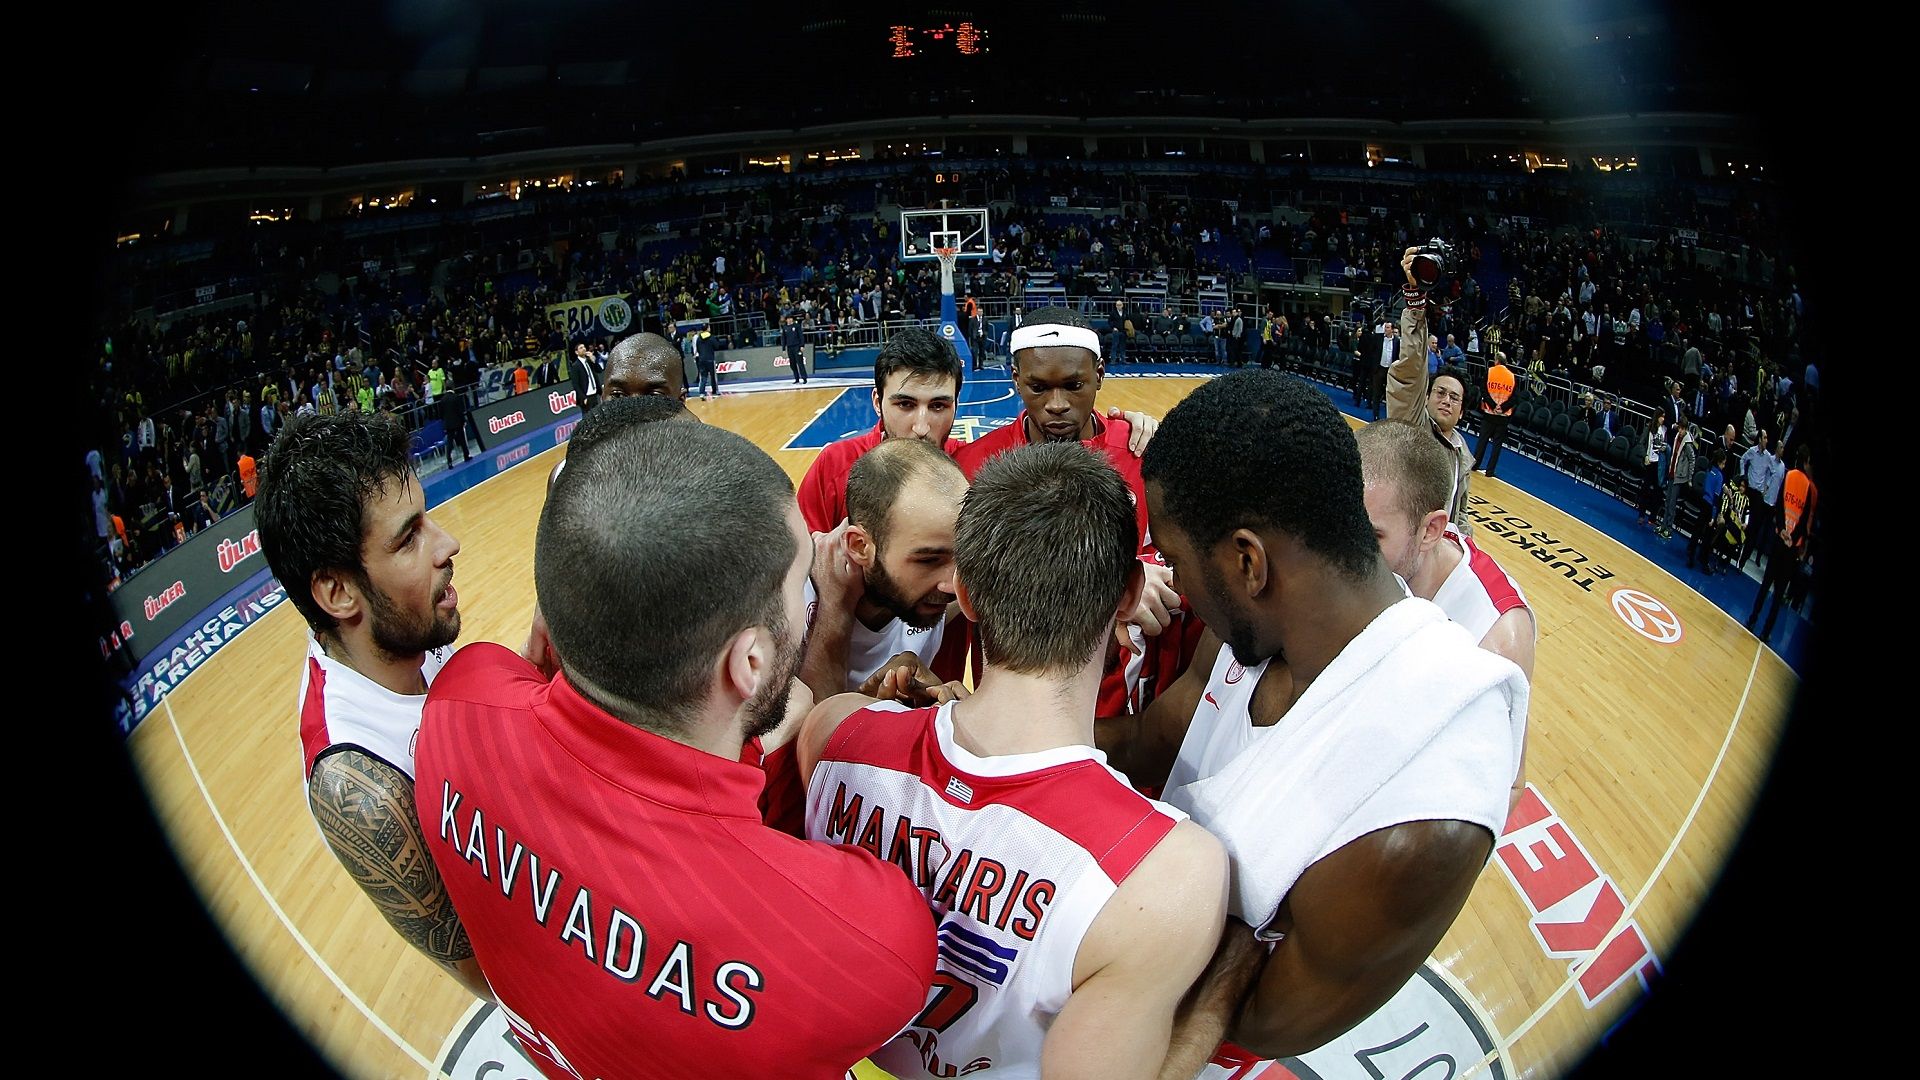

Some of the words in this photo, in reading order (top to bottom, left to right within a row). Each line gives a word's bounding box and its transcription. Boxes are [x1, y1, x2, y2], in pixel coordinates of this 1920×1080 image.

[488, 411, 526, 434] ÜLKER
[1467, 507, 1597, 592] TURKISH
[143, 580, 187, 621] ÜLKER
[153, 621, 245, 703] ARENA
[826, 781, 1057, 941] MANTARIS
[440, 779, 765, 1031] KAVVADAS
